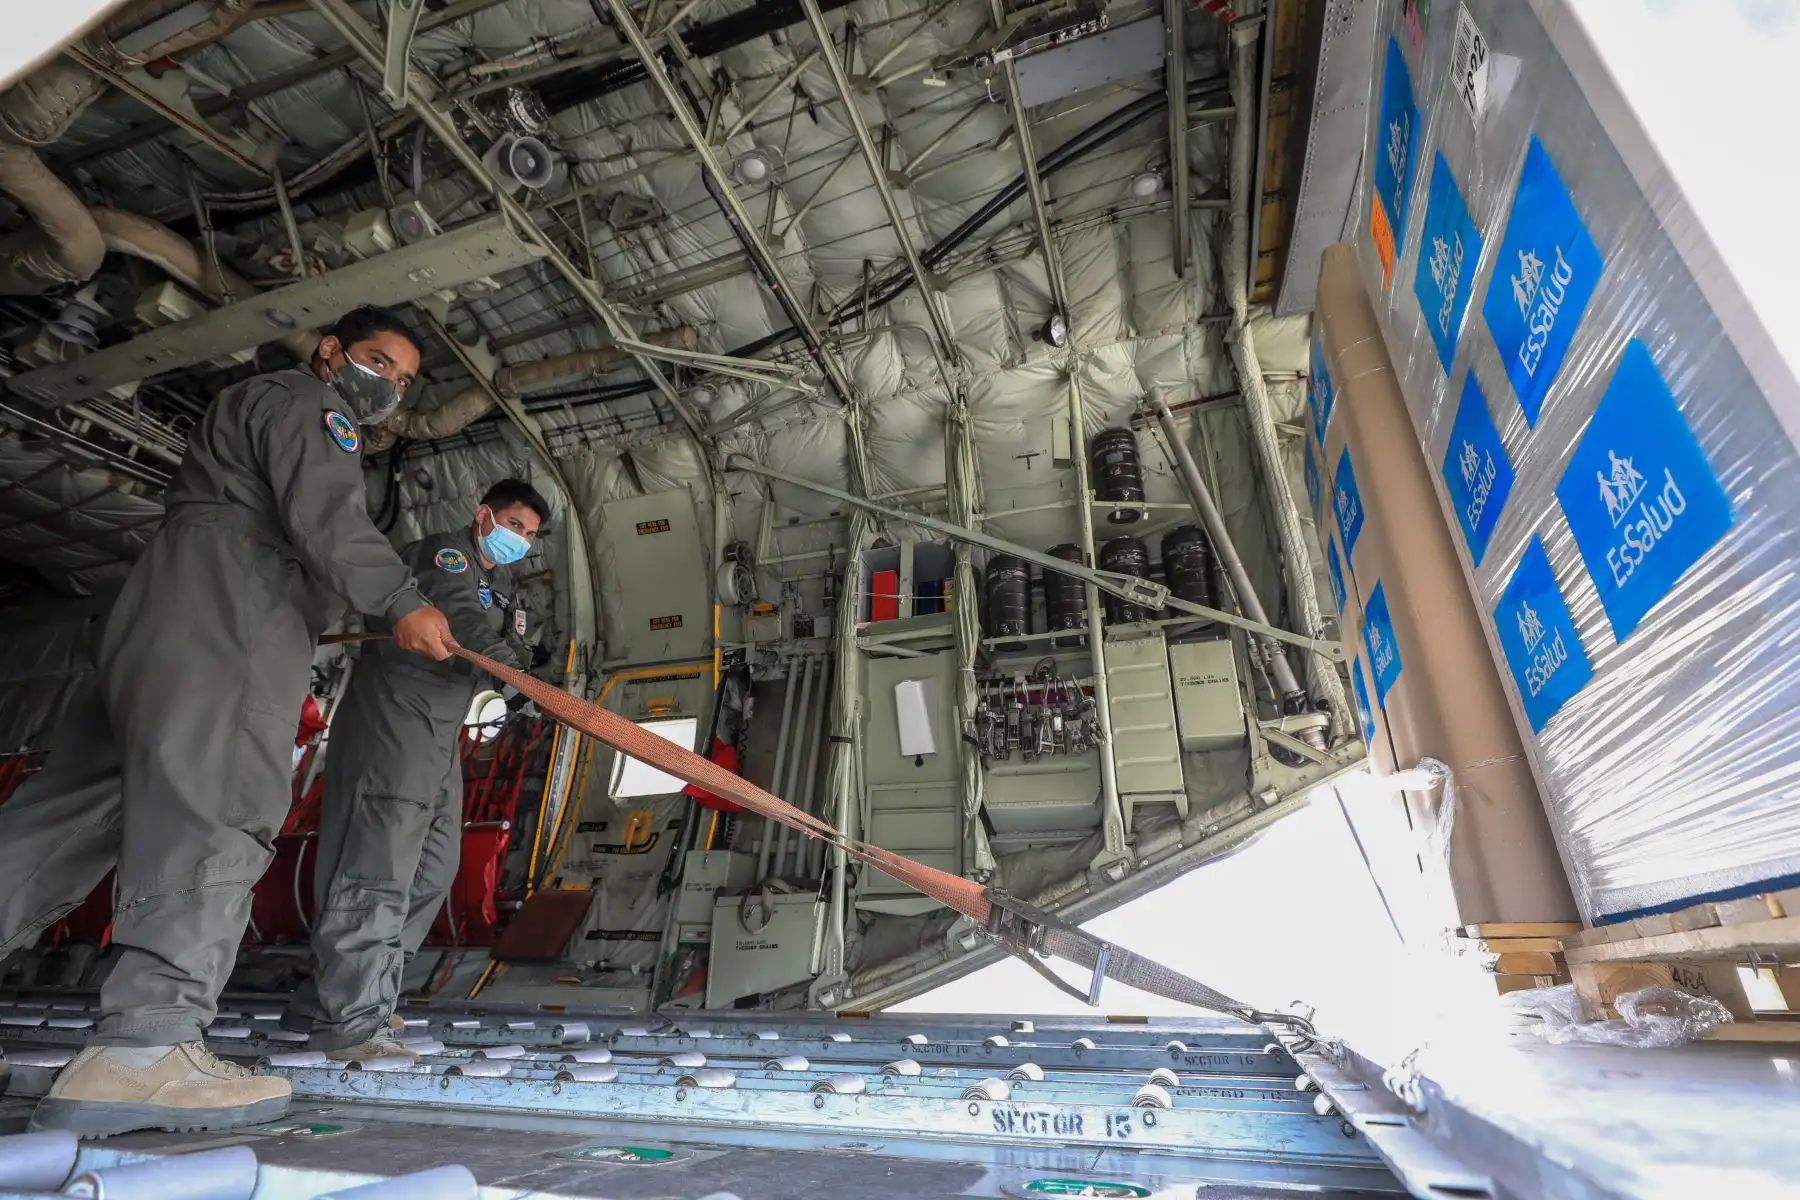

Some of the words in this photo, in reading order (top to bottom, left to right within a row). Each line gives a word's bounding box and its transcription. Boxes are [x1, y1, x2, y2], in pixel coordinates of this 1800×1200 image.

[1438, 230, 1464, 337] EsSalud
[1518, 244, 1574, 378] EsSalud
[1466, 449, 1497, 532] EsSalud
[1605, 467, 1688, 589] EsSalud
[1524, 628, 1568, 698] EsSalud
[1184, 1055, 1230, 1066] SECTOR
[1239, 1055, 1255, 1066] 16
[991, 1107, 1084, 1136] SECTOR
[1105, 1113, 1132, 1139] 15
